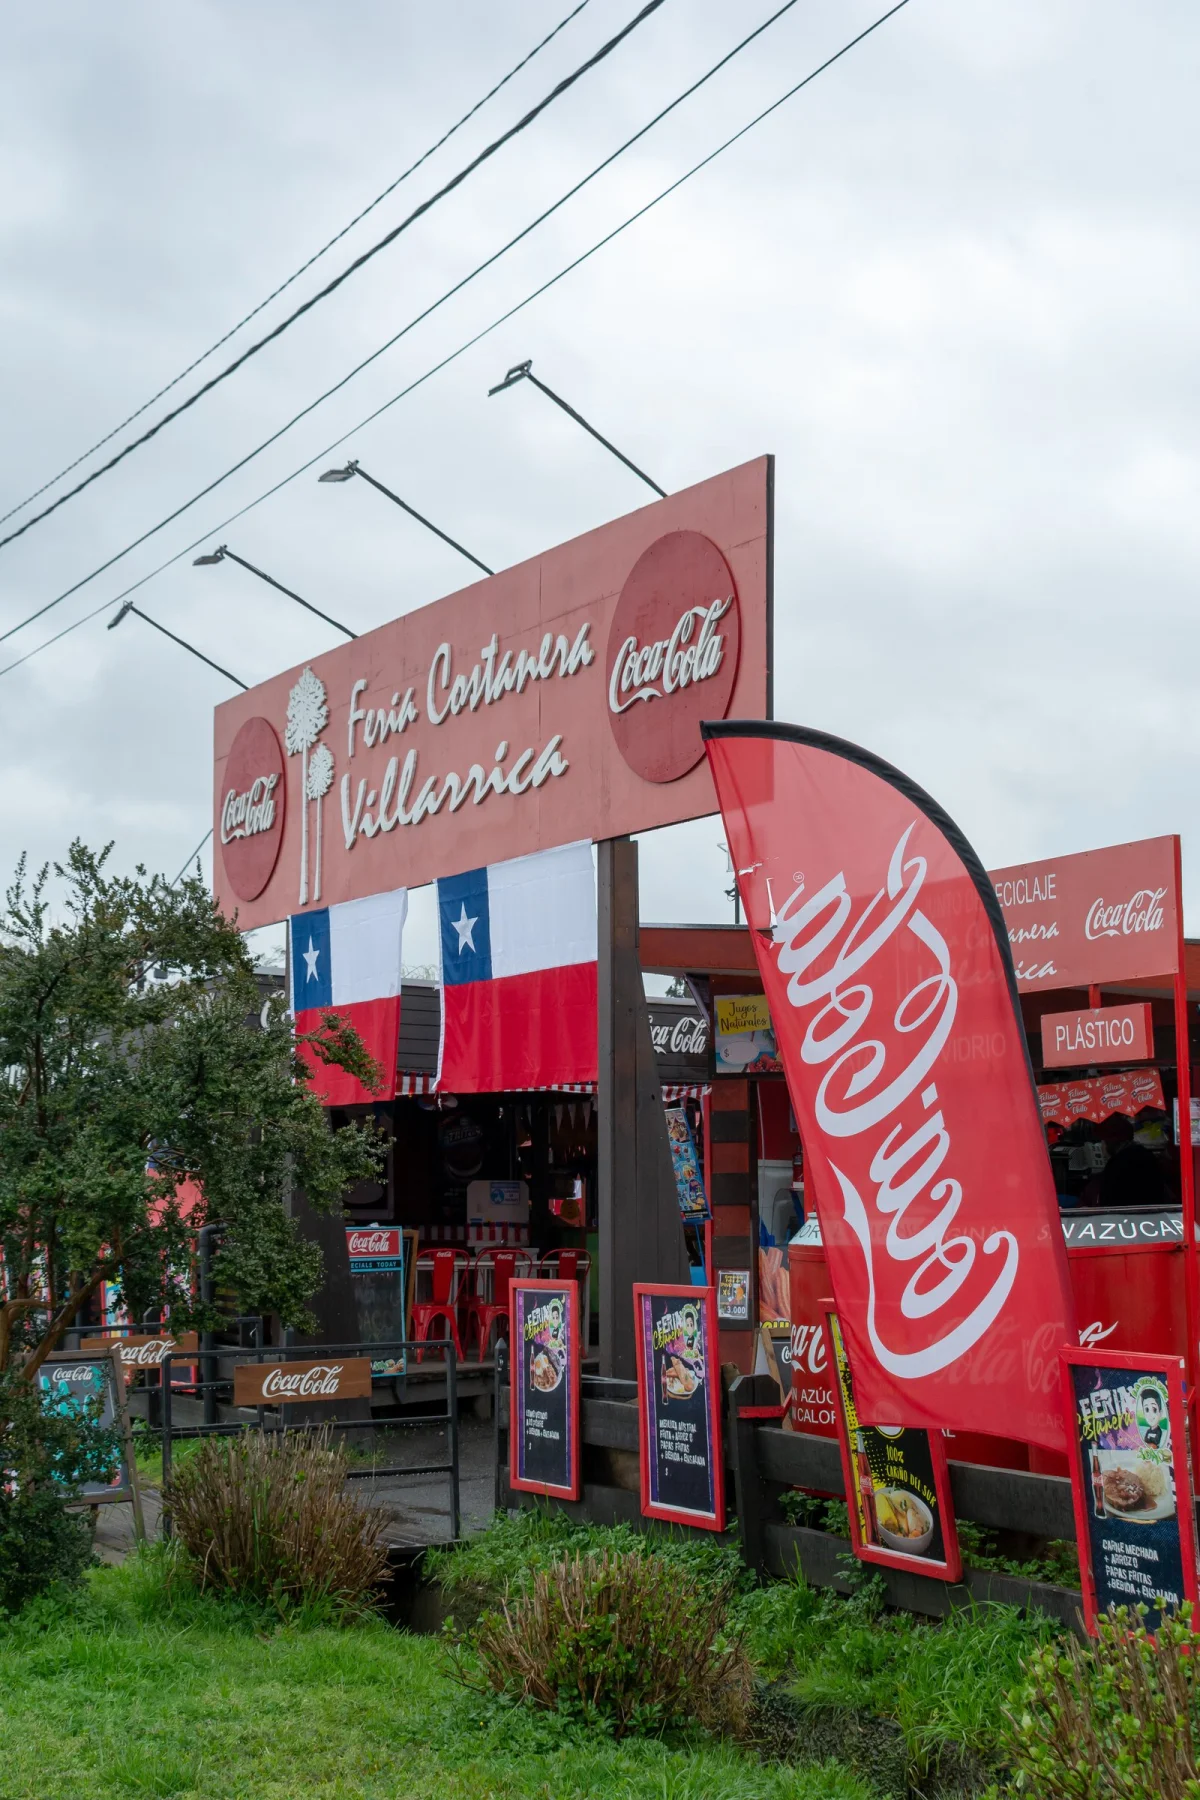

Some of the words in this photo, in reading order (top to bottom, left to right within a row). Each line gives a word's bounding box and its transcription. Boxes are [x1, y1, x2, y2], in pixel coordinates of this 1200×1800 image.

[609, 594, 734, 714] Coca-Cola
[347, 678, 420, 758] Feria
[427, 623, 595, 725] Costanera
[340, 734, 570, 850] Villarrica
[221, 773, 281, 844] Coca-Cola
[995, 874, 1057, 907] ECICLAJE
[1085, 888, 1168, 940] Coca-Cola
[1008, 922, 1059, 943] anera
[729, 1001, 758, 1019] Jugos
[720, 1014, 767, 1032] Naturales
[1055, 1018, 1135, 1051] PLÁSTICO
[348, 1232, 391, 1253] Coca-Cola
[376, 1261, 397, 1269] TODAY
[52, 1365, 93, 1382] Coca-Cola
[261, 1365, 344, 1398] Coca-Cola
[886, 1444, 904, 1463] 100%
[910, 1473, 921, 1491] DEL
[921, 1485, 937, 1508] SUR
[1102, 1539, 1125, 1553] CARNE
[1125, 1544, 1159, 1562] MECHADA
[1111, 1553, 1132, 1567] ARROZ
[1105, 1565, 1127, 1581] PAPAS
[1128, 1570, 1152, 1586] FRITAS
